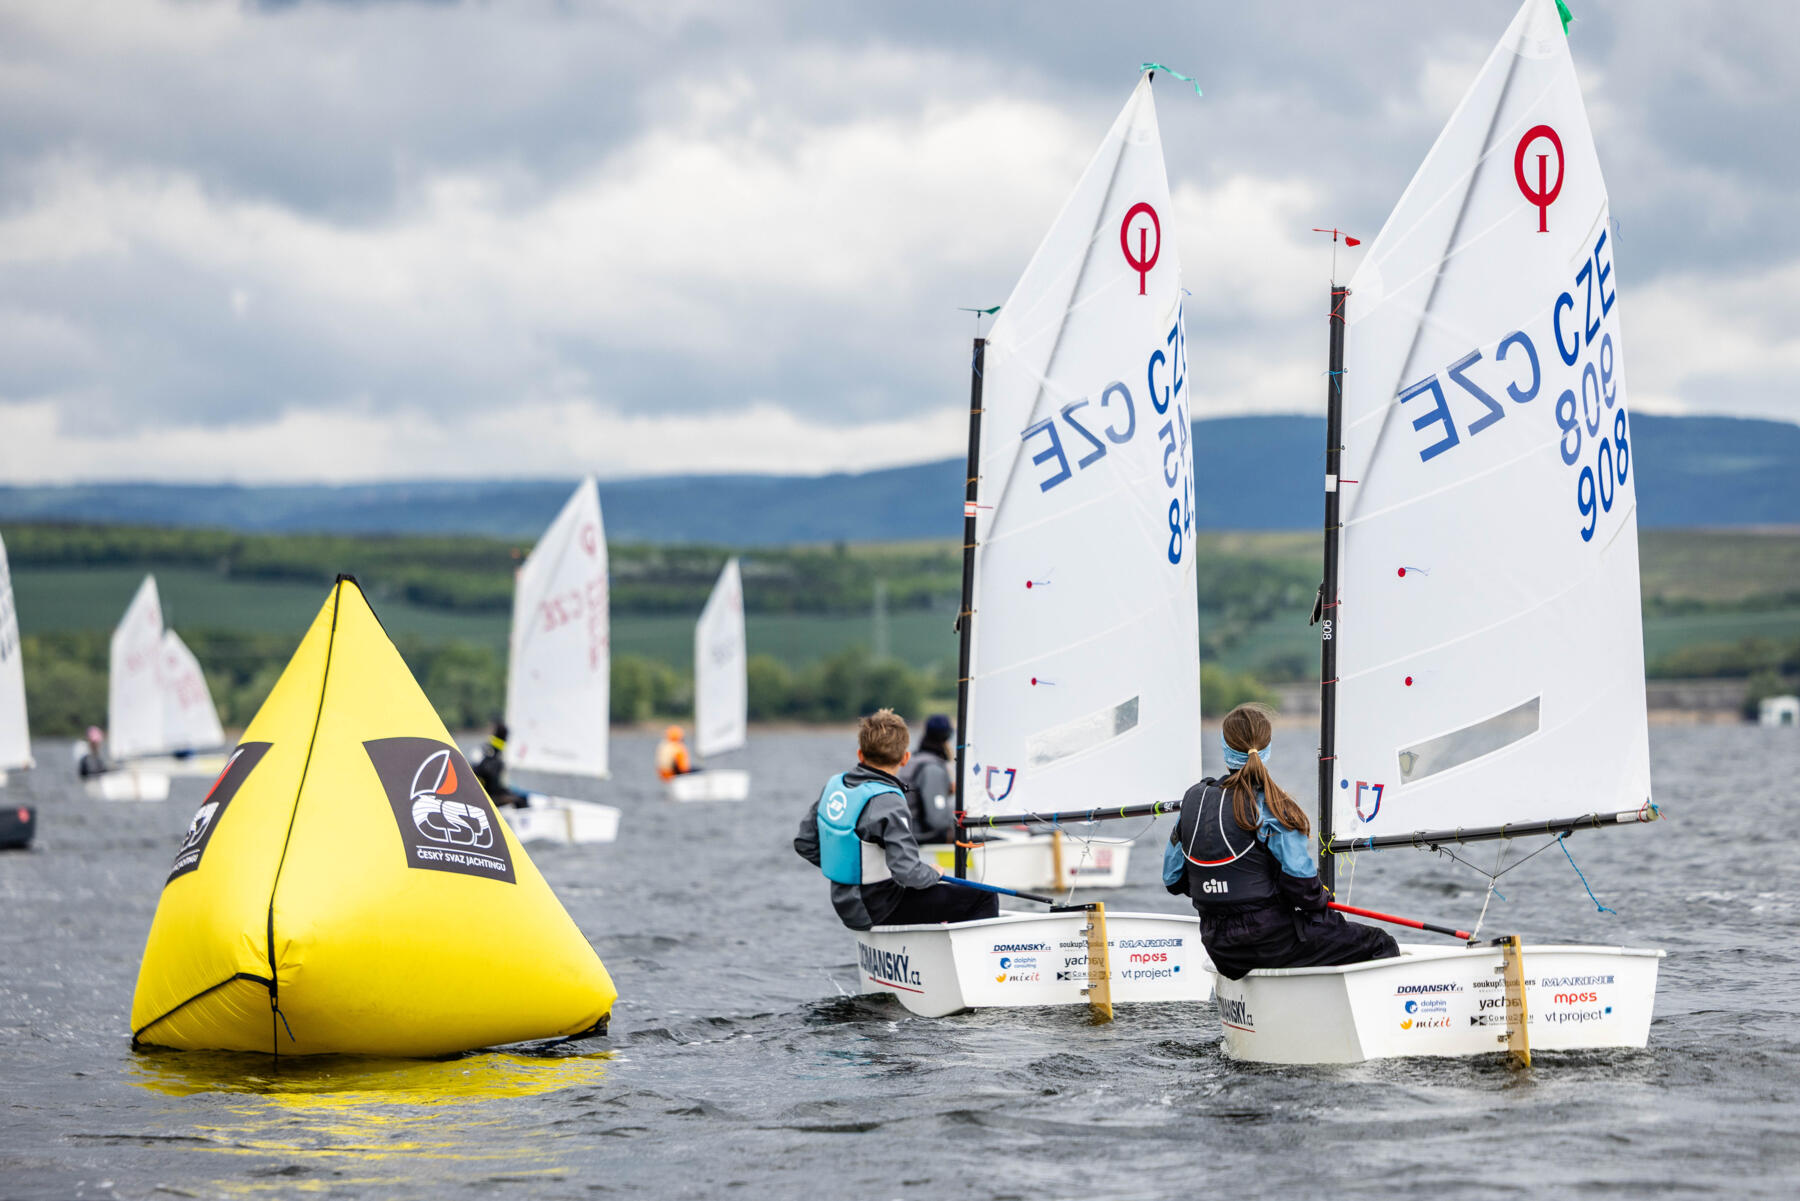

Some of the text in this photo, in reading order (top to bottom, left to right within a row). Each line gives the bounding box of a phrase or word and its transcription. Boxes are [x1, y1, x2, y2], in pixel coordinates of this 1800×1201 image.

[1553, 228, 1616, 367] CZE
[1577, 408, 1629, 542] 908
[1323, 619, 1332, 640] 908
[417, 848, 506, 872] ČESKÝ SVAZ JACHTINGU
[1203, 879, 1228, 893] Gill
[1119, 939, 1183, 948] MARINE
[1014, 957, 1037, 965] dolphin
[1009, 972, 1040, 982] mixit
[1121, 970, 1132, 978] vt
[1134, 968, 1172, 980] project
[1541, 975, 1615, 987] MARINE
[1421, 1000, 1447, 1008] dolphin
[1416, 1016, 1452, 1028] mixit
[1545, 1011, 1556, 1022] vt
[1559, 1010, 1602, 1024] project
